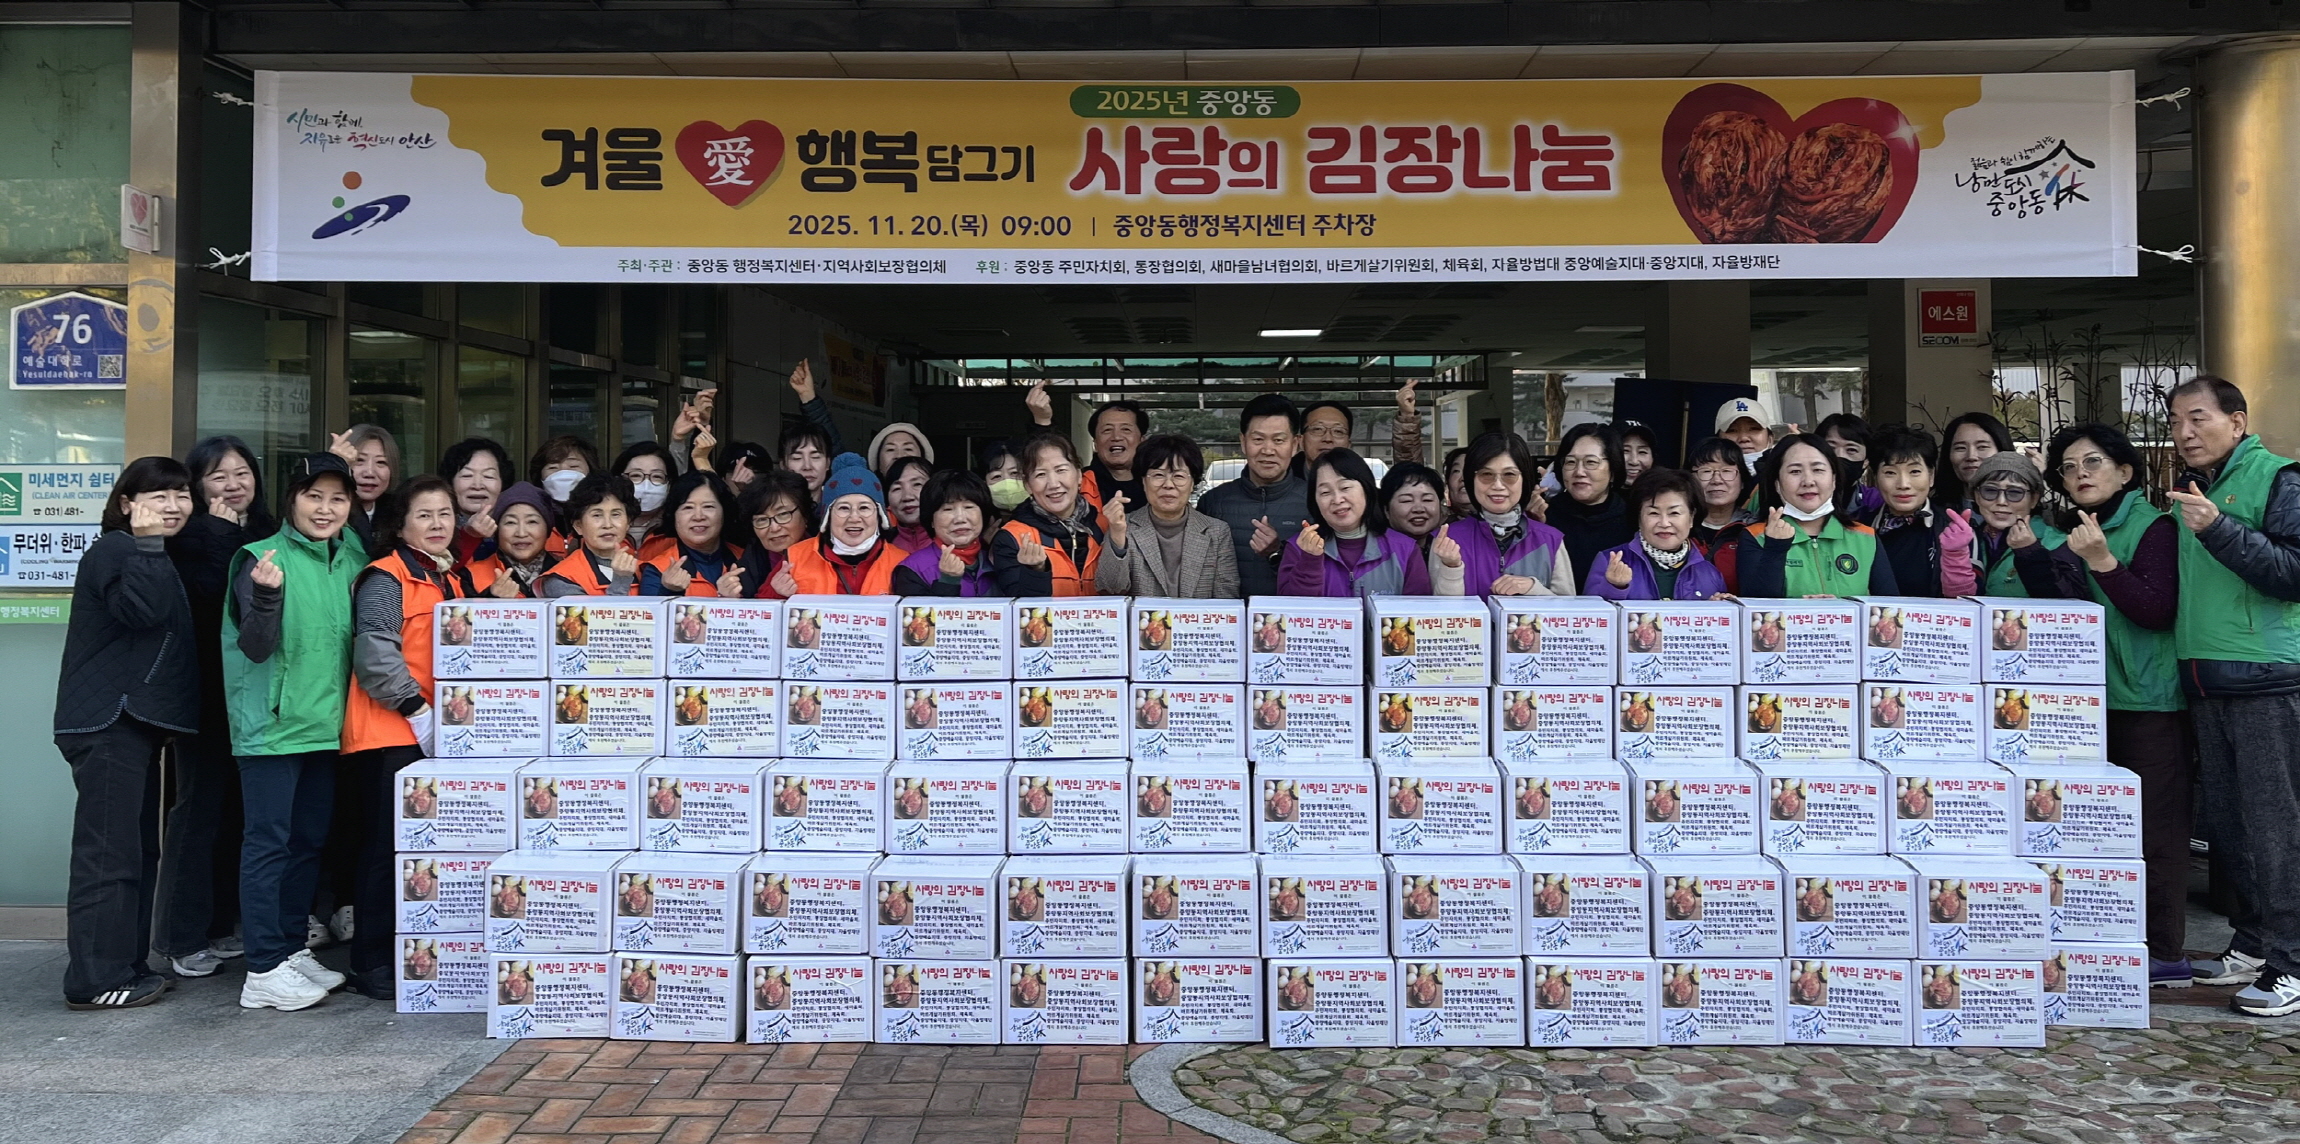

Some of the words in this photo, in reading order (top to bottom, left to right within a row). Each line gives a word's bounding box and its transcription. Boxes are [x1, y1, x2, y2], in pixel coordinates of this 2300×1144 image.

[1096, 90, 1189, 115] 2025년
[1196, 90, 1278, 116] 중앙동
[286, 108, 331, 132] 시민과
[398, 132, 437, 149] 안산
[540, 126, 663, 190] 겨울
[704, 136, 754, 186] 愛
[796, 128, 918, 194] 행복
[927, 144, 1035, 184] 담그기
[1069, 125, 1278, 195] 사랑의
[1306, 124, 1614, 194] 김장나눔
[1986, 189, 2046, 218] 중앙동
[788, 215, 859, 236] 2025.
[868, 215, 903, 236] 11.
[911, 213, 988, 238] 20.(목)
[1002, 214, 1072, 236] 09:00
[1114, 214, 1306, 238] 중앙동행정복지센터
[1312, 214, 1377, 238] 주차장
[687, 258, 730, 274] 중앙동
[976, 258, 1000, 274] 후원
[1014, 259, 1054, 274] 중앙동
[1058, 259, 1130, 275] 주민자치회,
[1134, 259, 1206, 275] 통장협의회,
[1210, 258, 1322, 275] 새마을남녀협의회,
[1326, 258, 1438, 274] 바르게살기위원회,
[1442, 258, 1487, 274] 체육회,
[1492, 258, 1560, 272] 자율방법대
[1712, 255, 1780, 271] 자율방재단
[1928, 306, 1968, 321] 에스원
[52, 314, 92, 344] 76
[1922, 336, 1960, 345] SECOM
[1736, 400, 1748, 412] LA
[28, 472, 82, 488] 미세먼지
[88, 472, 115, 488] 쉼터
[32, 492, 60, 500] (CLEAN
[63, 492, 76, 500] AIR
[475, 610, 499, 619] 사랑의
[1054, 610, 1079, 620] 사랑의
[1787, 615, 1813, 625] 사랑의
[1416, 619, 1442, 629] 사랑의
[590, 688, 616, 698] 사랑의
[1539, 694, 1564, 704] 사랑의
[440, 781, 466, 791] 사랑의
[810, 780, 836, 790] 사랑의
[1055, 780, 1081, 790] 사랑의
[1426, 782, 1452, 792] 사랑의
[1683, 784, 1709, 794] 사랑의
[1935, 781, 1963, 791] 사랑의
[2066, 868, 2094, 880] 사랑의
[2099, 870, 2137, 882] 김장나눔
[529, 880, 556, 891] 사랑의
[561, 881, 598, 893] 김장나눔
[656, 878, 683, 889] 사랑의
[688, 879, 725, 890] 김장나눔
[791, 878, 819, 889] 사랑의
[824, 879, 861, 890] 김장나눔
[1046, 881, 1074, 891] 사랑의
[1079, 881, 1116, 892] 김장나눔
[1181, 880, 1208, 890] 사랑의
[1213, 880, 1250, 890] 김장나눔
[1307, 880, 1335, 891] 사랑의
[1340, 880, 1377, 891] 김장나눔
[1440, 879, 1468, 889] 사랑의
[1473, 878, 1511, 889] 김장나눔
[1571, 877, 1599, 888] 사랑의
[1604, 877, 1642, 888] 김장나눔
[1703, 880, 1732, 891] 사랑의
[1737, 880, 1775, 891] 김장나눔
[1835, 881, 1863, 892] 사랑의
[1868, 881, 1907, 892] 김장나눔
[916, 885, 943, 896] 사랑의
[947, 886, 984, 896] 김장나눔
[1969, 883, 1998, 893] 사랑의
[2003, 883, 2042, 894] 김장나눔
[2068, 954, 2097, 965] 사랑의
[2102, 955, 2140, 967] 김장나눔
[536, 963, 564, 975] 사랑의
[569, 962, 606, 974] 김장나눔
[659, 964, 687, 976] 사랑의
[691, 966, 728, 978] 김장나눔
[793, 968, 820, 980] 사랑의
[825, 967, 863, 979] 김장나눔
[921, 968, 948, 979] 사랑의
[953, 968, 990, 979] 김장나눔
[1182, 965, 1210, 976] 사랑의
[1215, 965, 1252, 976] 김장나눔
[1445, 968, 1473, 978] 사랑의
[1478, 968, 1515, 978] 김장나눔
[1830, 966, 1859, 978] 사랑의
[1863, 968, 1902, 981] 김장나눔
[1961, 969, 1990, 979] 사랑의
[1995, 968, 2034, 979] 김장나눔
[1049, 968, 1076, 980] 사랑의
[1081, 969, 1118, 981] 김장나눔
[1316, 971, 1344, 981] 사랑의
[1349, 971, 1387, 981] 김장나눔
[1574, 969, 1602, 980] 사랑의
[1607, 970, 1644, 981] 김장나눔
[1701, 968, 1730, 979] 사랑의
[1735, 969, 1773, 981] 김장나눔
